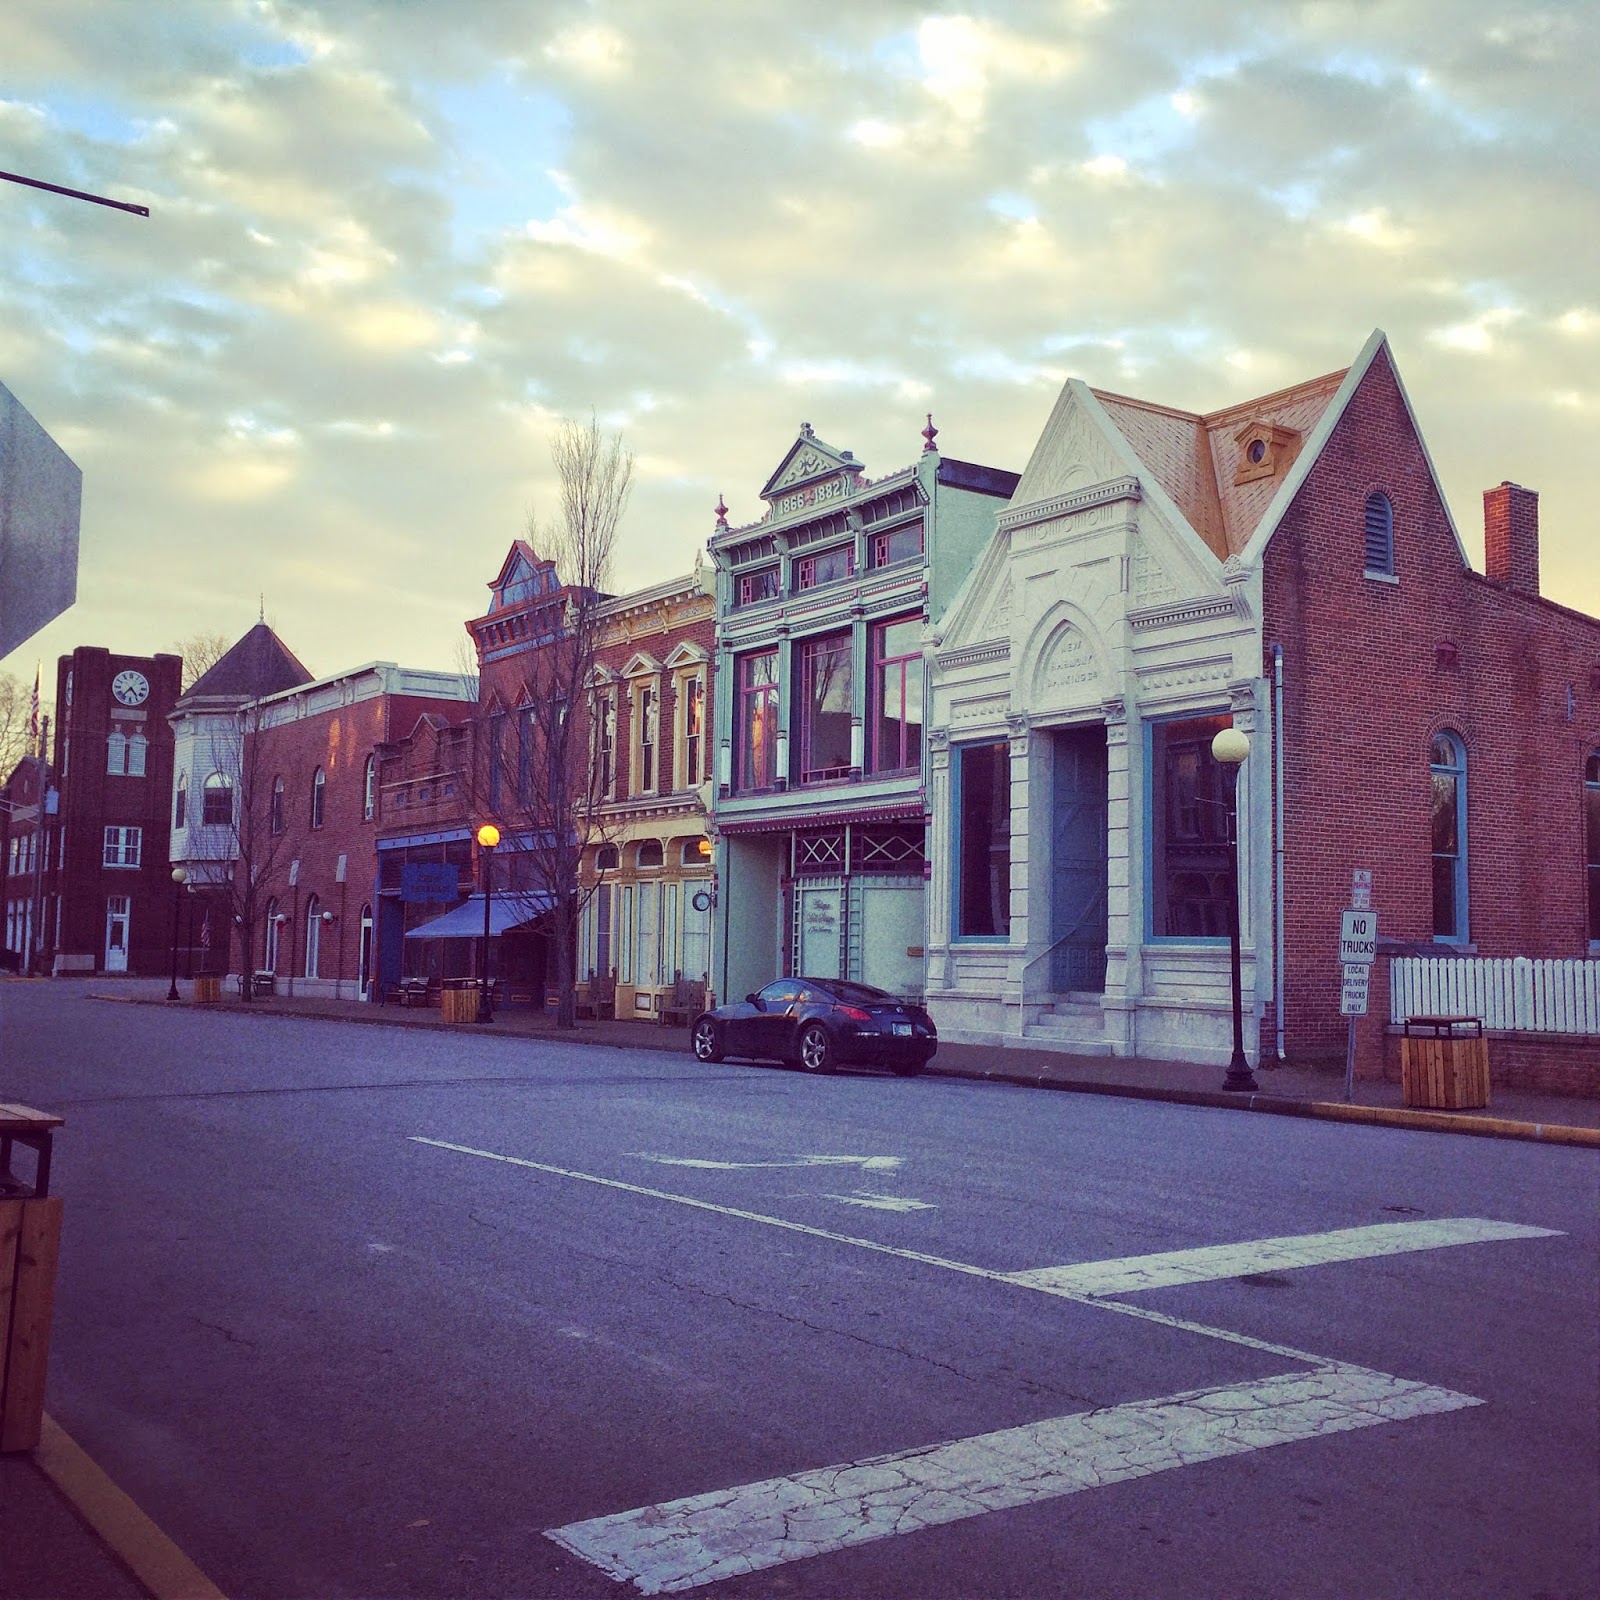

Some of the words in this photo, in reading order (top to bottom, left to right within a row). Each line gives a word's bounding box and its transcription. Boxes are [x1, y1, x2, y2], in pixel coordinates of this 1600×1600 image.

[780, 494, 804, 515] 1866
[814, 480, 840, 504] 1882
[1352, 919, 1367, 935] NO
[1342, 940, 1375, 954] TRUCKS
[1347, 965, 1366, 975] LOCAL
[1344, 978, 1368, 987] DELIVERY
[1344, 991, 1366, 1000] TRUCKS
[1347, 1003, 1361, 1012] ONLY
